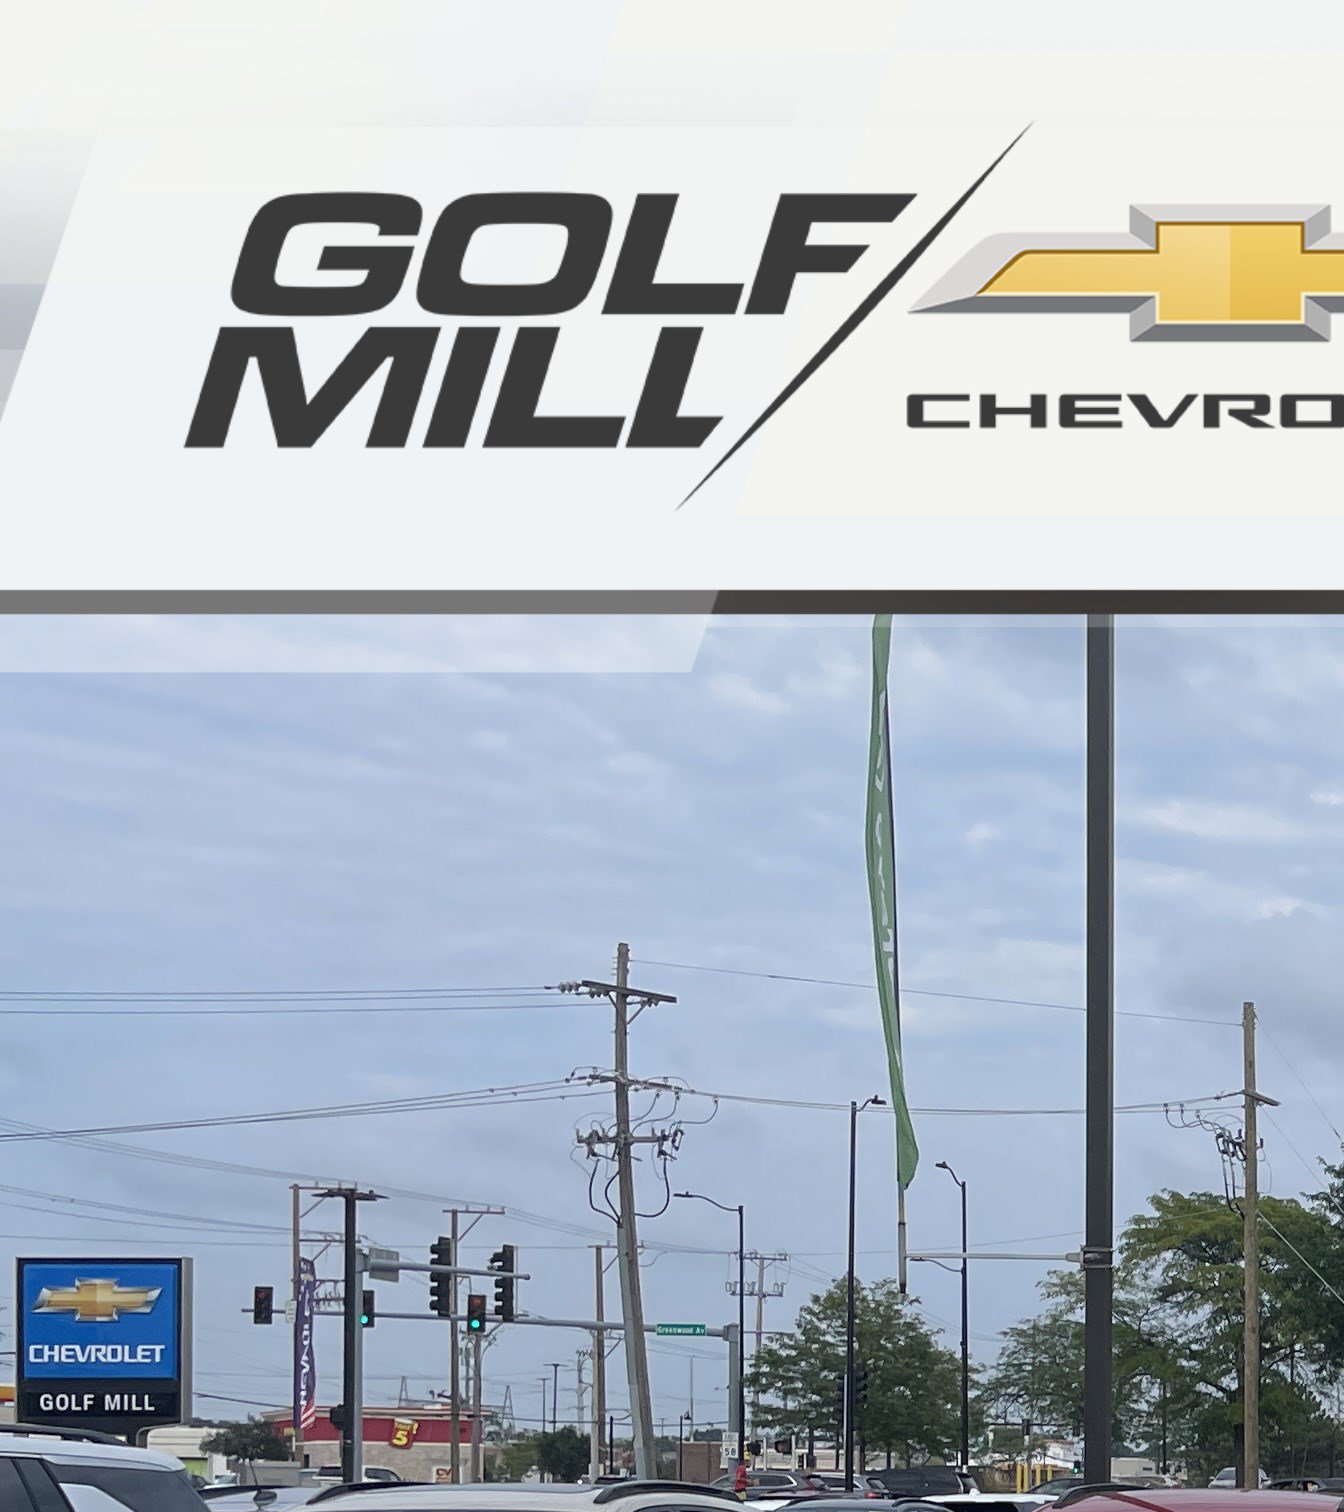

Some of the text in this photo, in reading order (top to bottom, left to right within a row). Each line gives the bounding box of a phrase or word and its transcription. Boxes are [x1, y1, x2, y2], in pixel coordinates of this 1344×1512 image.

[657, 1325, 694, 1335] Greenwood
[28, 1344, 166, 1364] CHEVROLET
[39, 1393, 156, 1412] GOLF MILL
